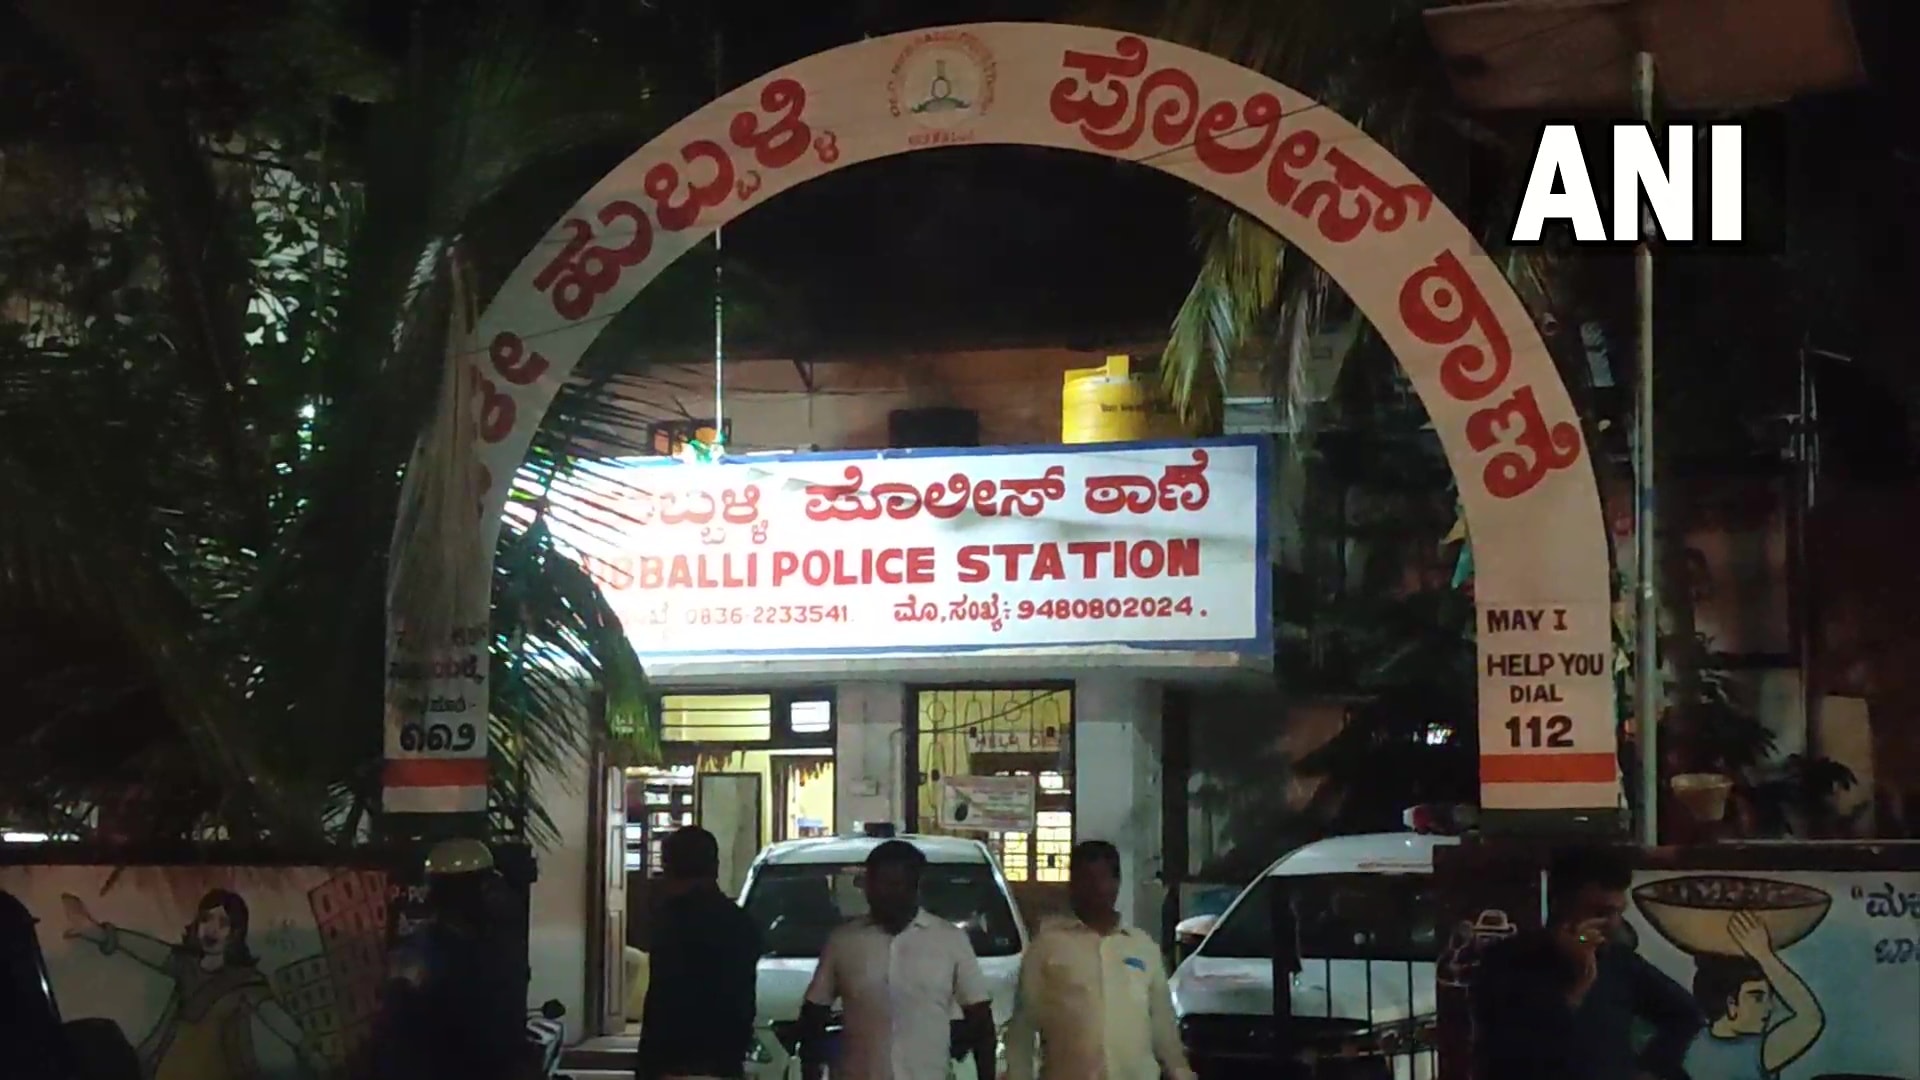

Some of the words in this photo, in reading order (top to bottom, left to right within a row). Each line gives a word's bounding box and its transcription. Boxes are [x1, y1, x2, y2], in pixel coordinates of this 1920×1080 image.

[1398, 248, 1581, 499] ಠಾಣೆ
[1085, 448, 1210, 515] ಠಾಣೆ
[772, 546, 935, 587] POLICE
[957, 537, 1200, 583] STATION
[1486, 609, 1544, 633] MAY
[1553, 609, 1568, 631] I
[1486, 653, 1554, 677] HELP
[1558, 653, 1604, 676] YOU
[1509, 684, 1564, 704] DIAL
[1504, 714, 1575, 748] 112
